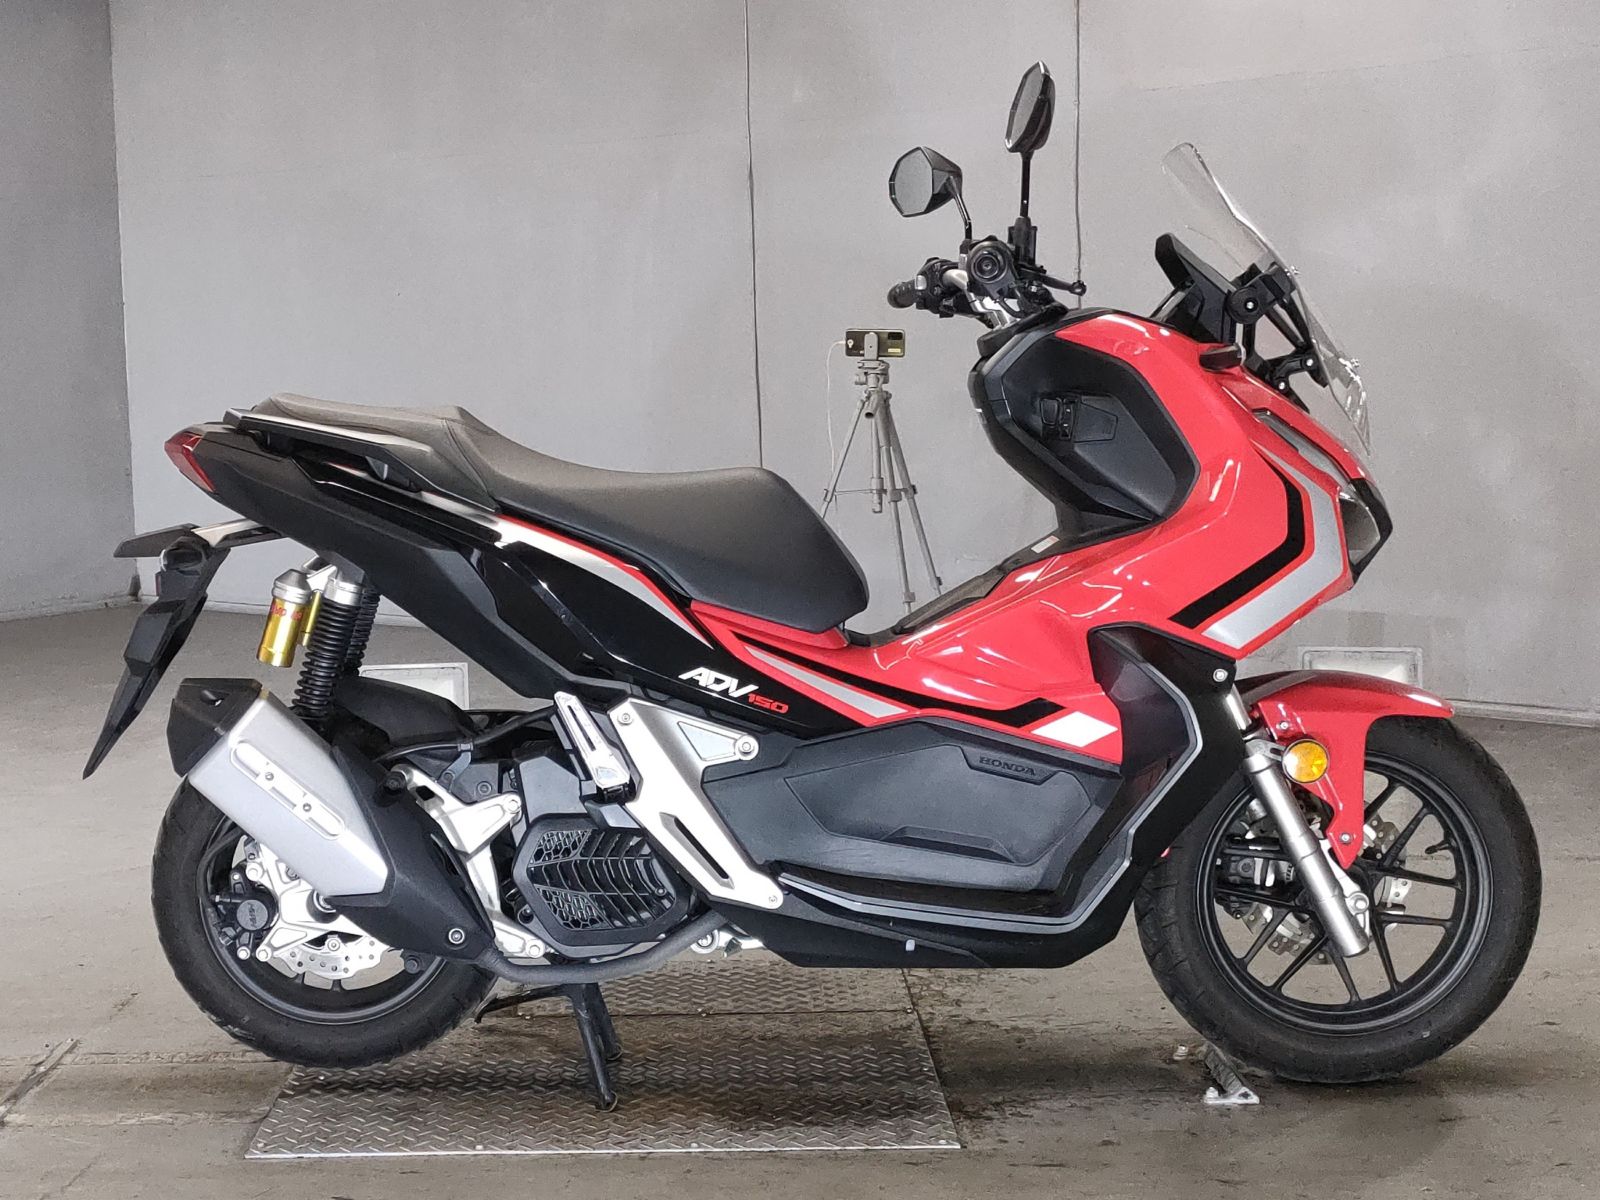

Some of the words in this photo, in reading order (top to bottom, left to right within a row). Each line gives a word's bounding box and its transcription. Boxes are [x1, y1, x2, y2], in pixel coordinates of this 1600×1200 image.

[678, 666, 759, 698] ADV
[748, 693, 789, 714] 150
[979, 756, 1036, 776] HONDA
